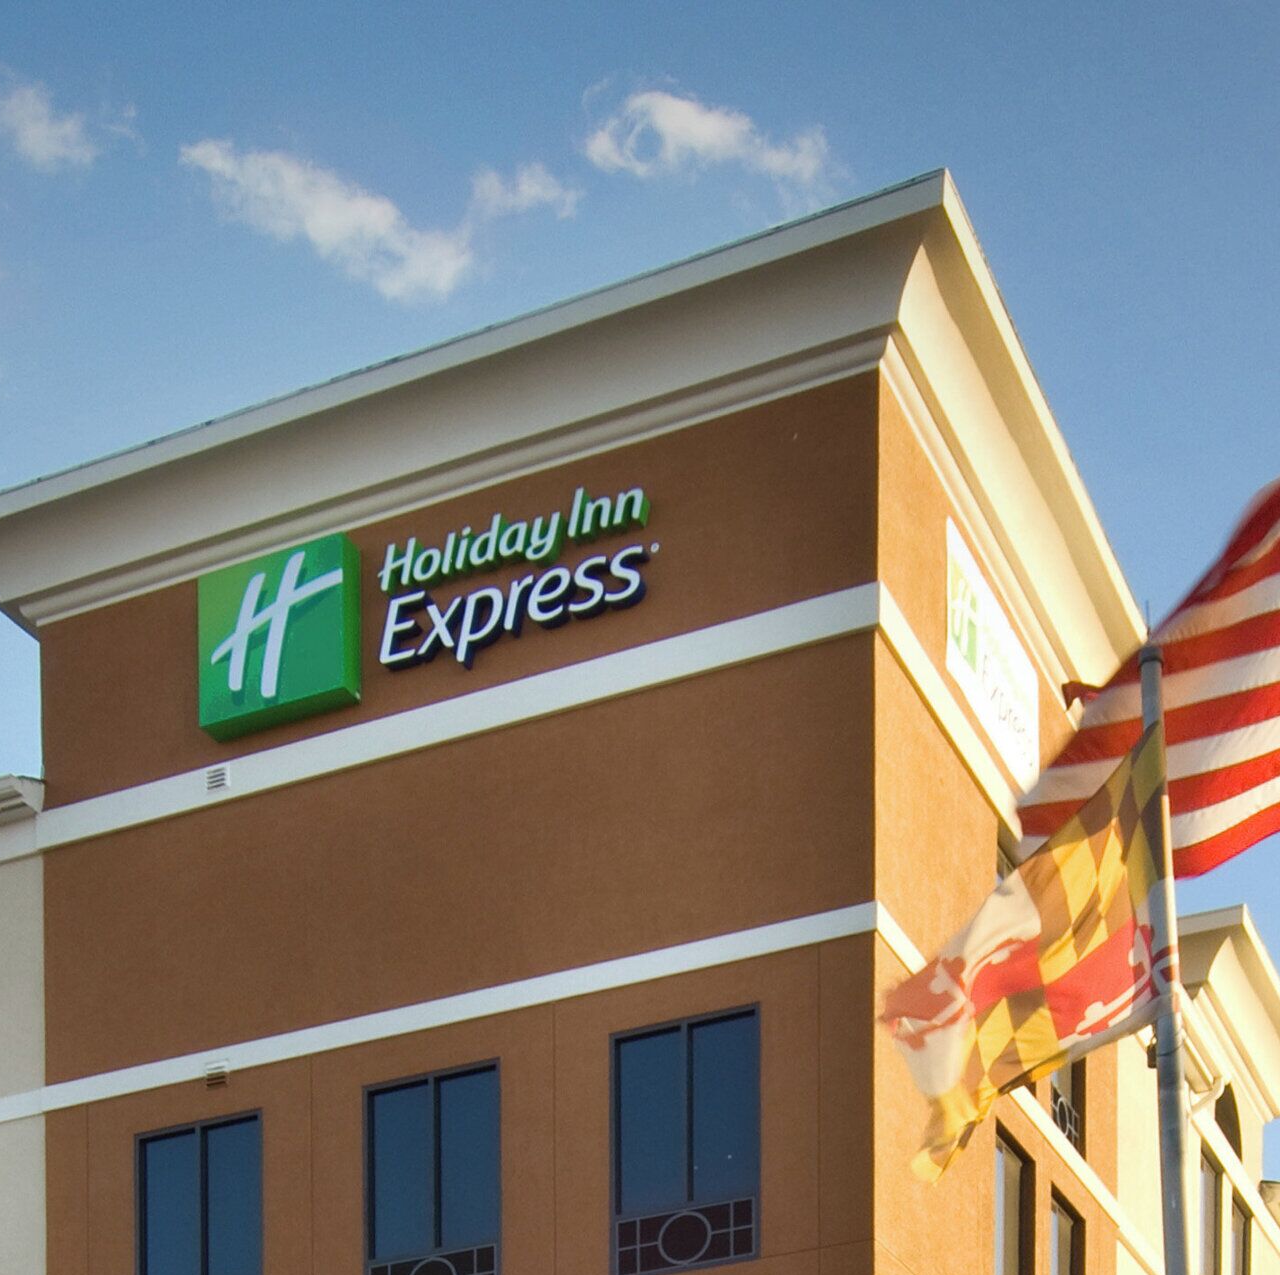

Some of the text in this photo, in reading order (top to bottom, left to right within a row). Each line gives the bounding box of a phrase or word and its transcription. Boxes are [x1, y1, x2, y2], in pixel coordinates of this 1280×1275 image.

[377, 486, 648, 592] Holiday Inn
[378, 544, 646, 664] Express
